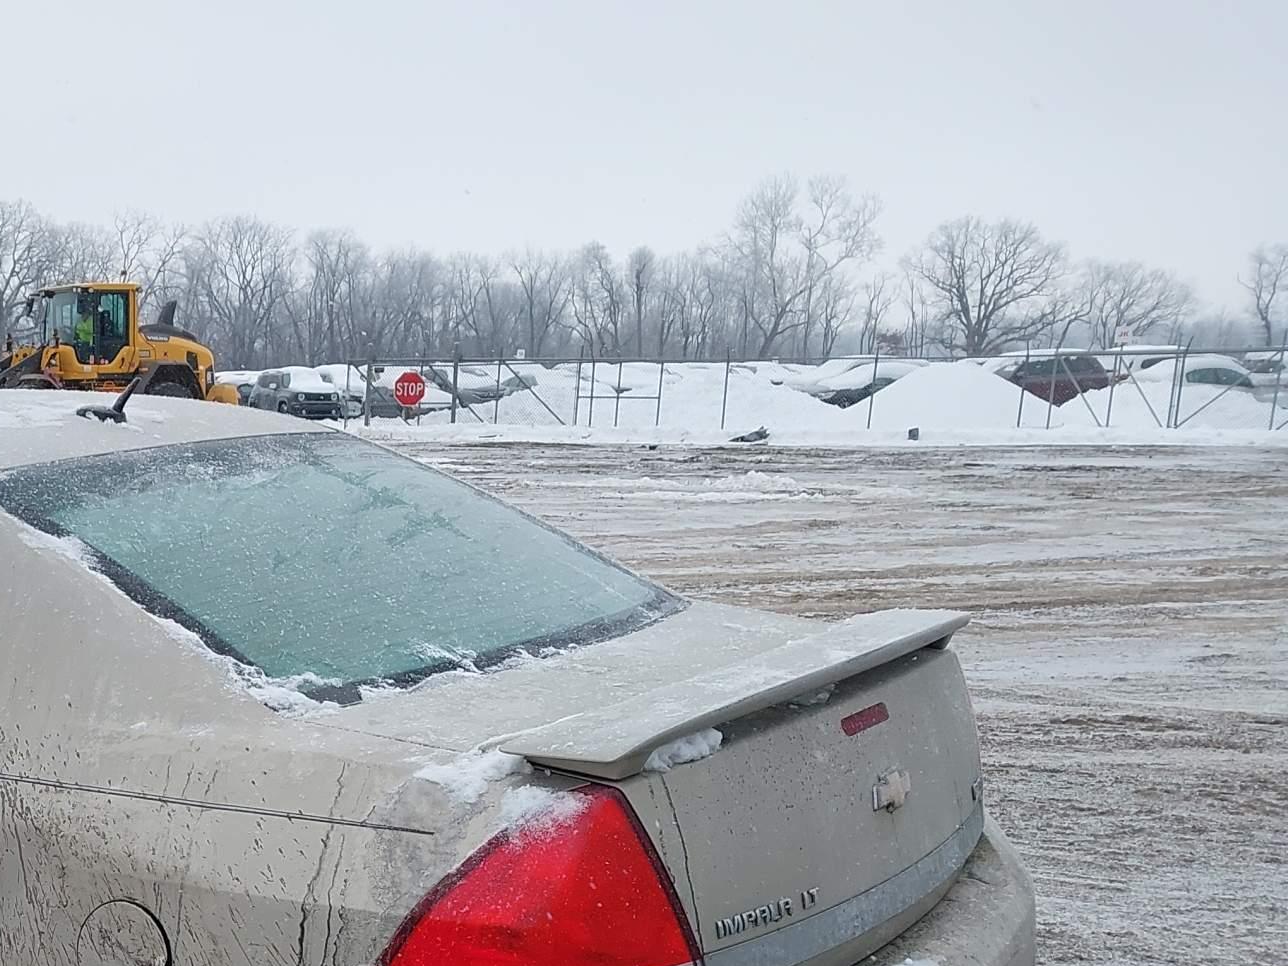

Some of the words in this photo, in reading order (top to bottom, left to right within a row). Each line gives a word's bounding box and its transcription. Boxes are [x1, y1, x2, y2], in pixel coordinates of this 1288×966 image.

[396, 382, 424, 397] STOP
[715, 898, 793, 939] IMPALA
[800, 886, 820, 910] LT
